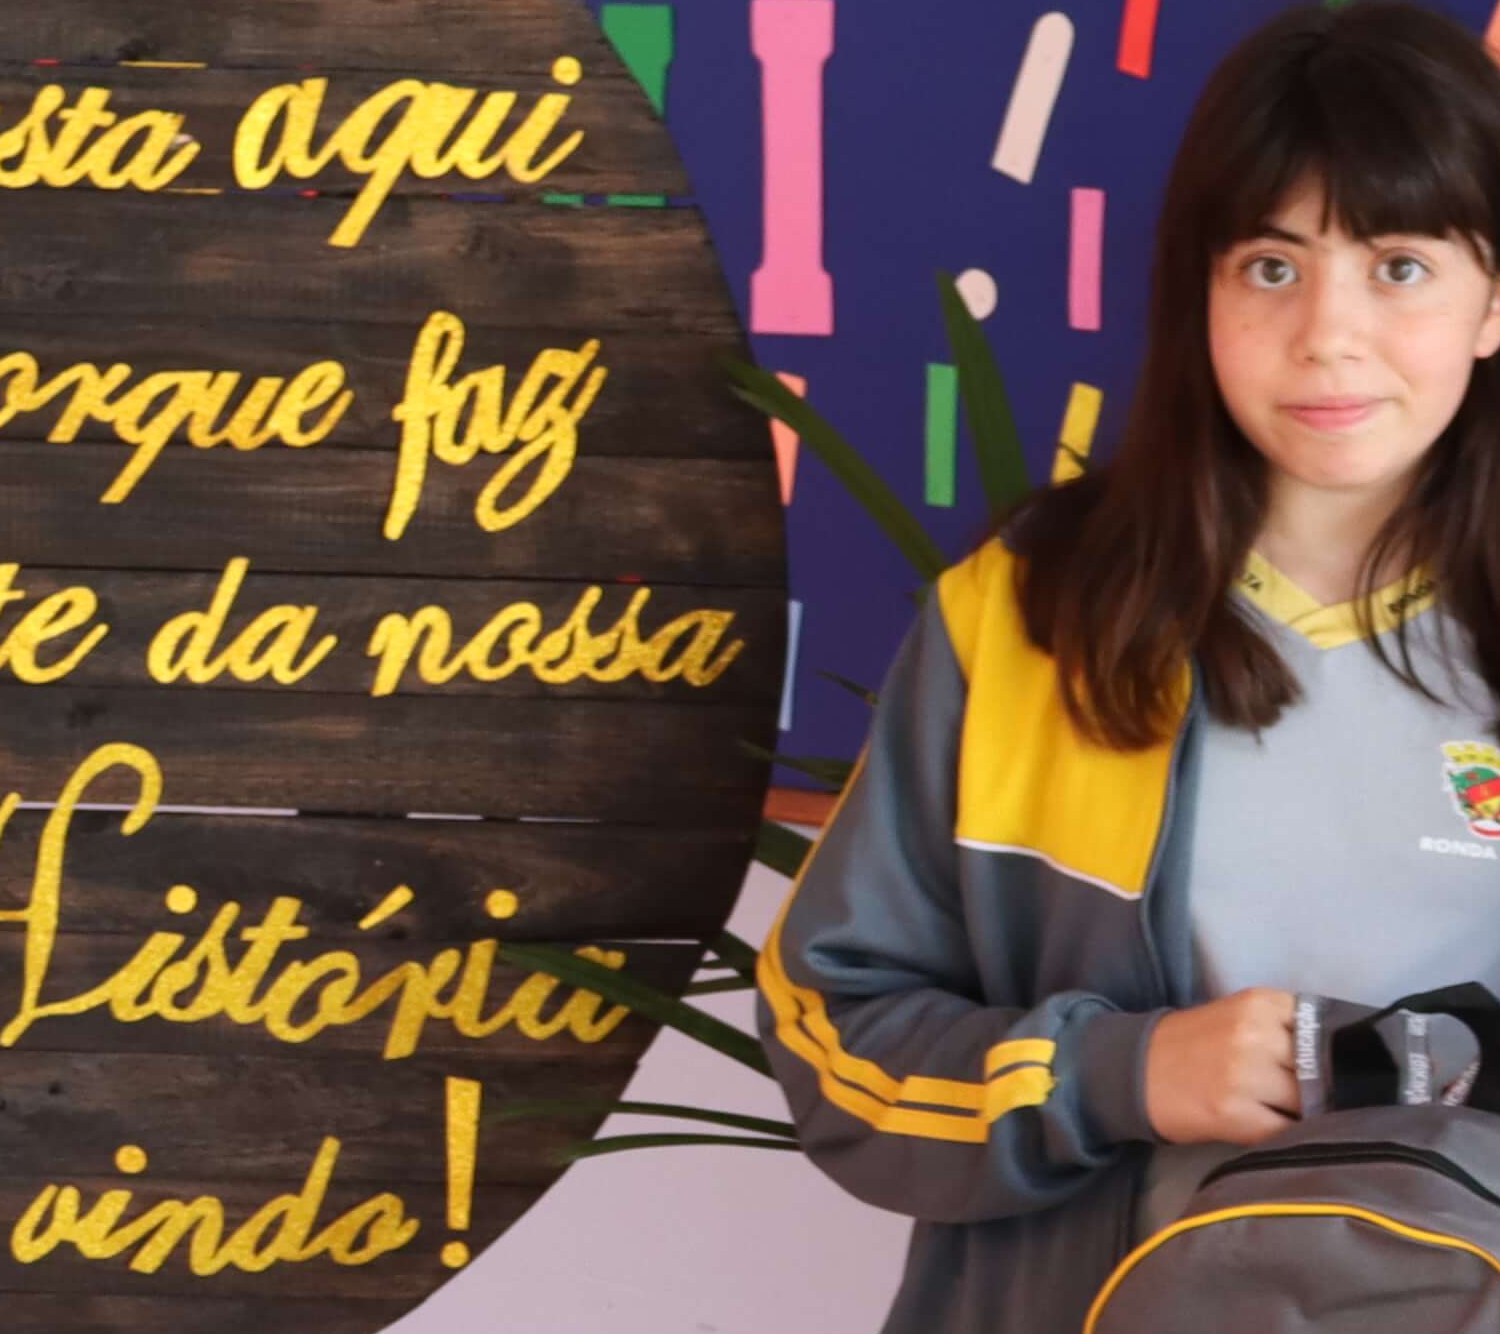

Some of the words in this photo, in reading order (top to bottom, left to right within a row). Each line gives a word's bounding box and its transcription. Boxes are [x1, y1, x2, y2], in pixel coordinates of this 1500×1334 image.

[232, 55, 585, 248] aqui
[147, 556, 338, 686] da
[368, 585, 745, 698] nossa
